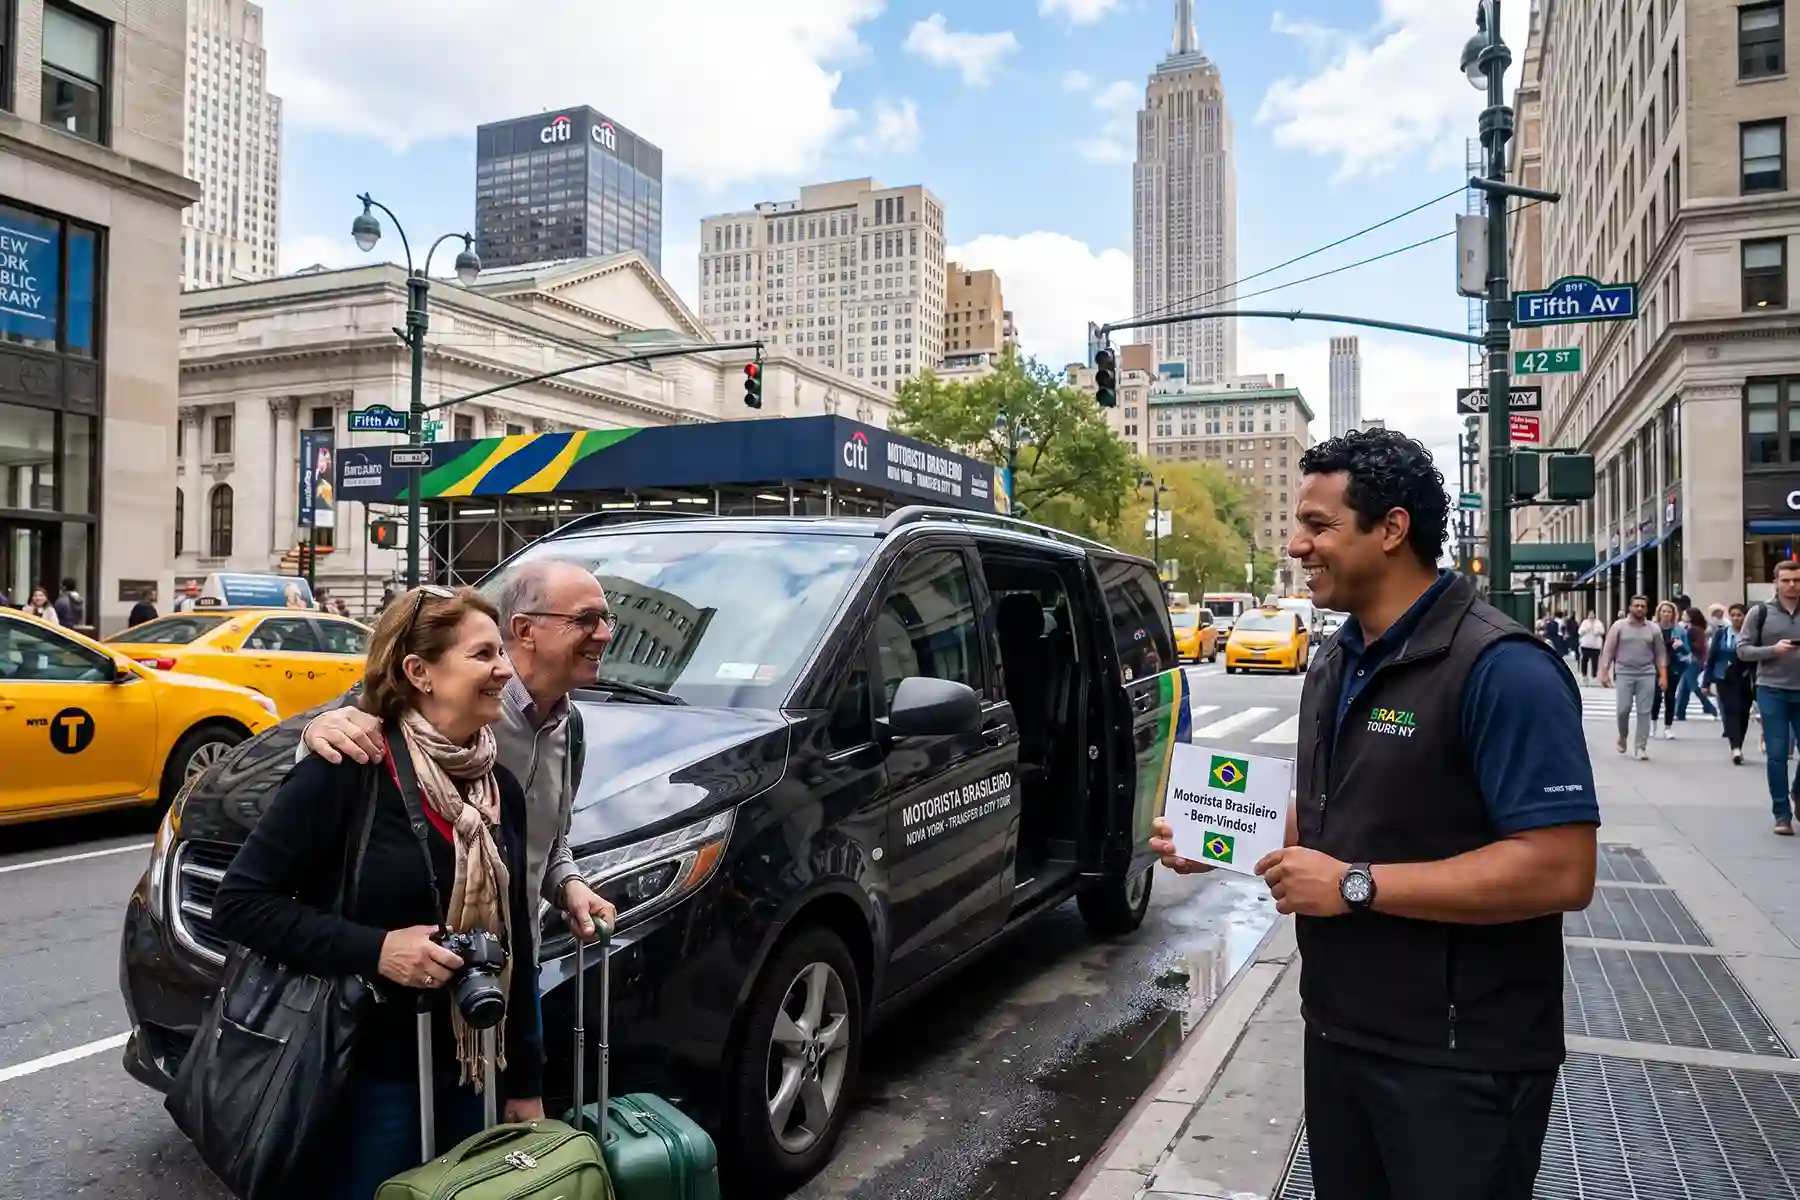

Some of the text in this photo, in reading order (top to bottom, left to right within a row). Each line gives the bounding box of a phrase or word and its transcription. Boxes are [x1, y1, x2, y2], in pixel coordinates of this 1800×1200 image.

[541, 118, 571, 144] citi
[592, 124, 615, 151] citi
[0, 235, 28, 254] EW
[0, 252, 29, 273] ORK
[0, 270, 37, 292] BLIC
[0, 286, 41, 309] RARY
[1529, 294, 1620, 317] Fifth Av
[1522, 351, 1570, 372] 42 ST
[1470, 394, 1489, 406] ON
[354, 415, 400, 427] Fifth Av
[844, 438, 868, 470] citi
[1370, 708, 1416, 727] BRAZIL
[61, 716, 85, 748] T
[1367, 721, 1416, 738] TOURS NY
[902, 771, 1011, 827] MOTORISTA BRASILEIRO
[1173, 788, 1278, 820] Motorista Brasileiro
[906, 827, 926, 847] NOVA
[926, 820, 945, 838] YORK
[948, 807, 978, 828] TRANSFER
[984, 799, 996, 815] CITY
[996, 794, 1011, 811] TOUR
[1190, 809, 1257, 834] Bem-Vindos!
